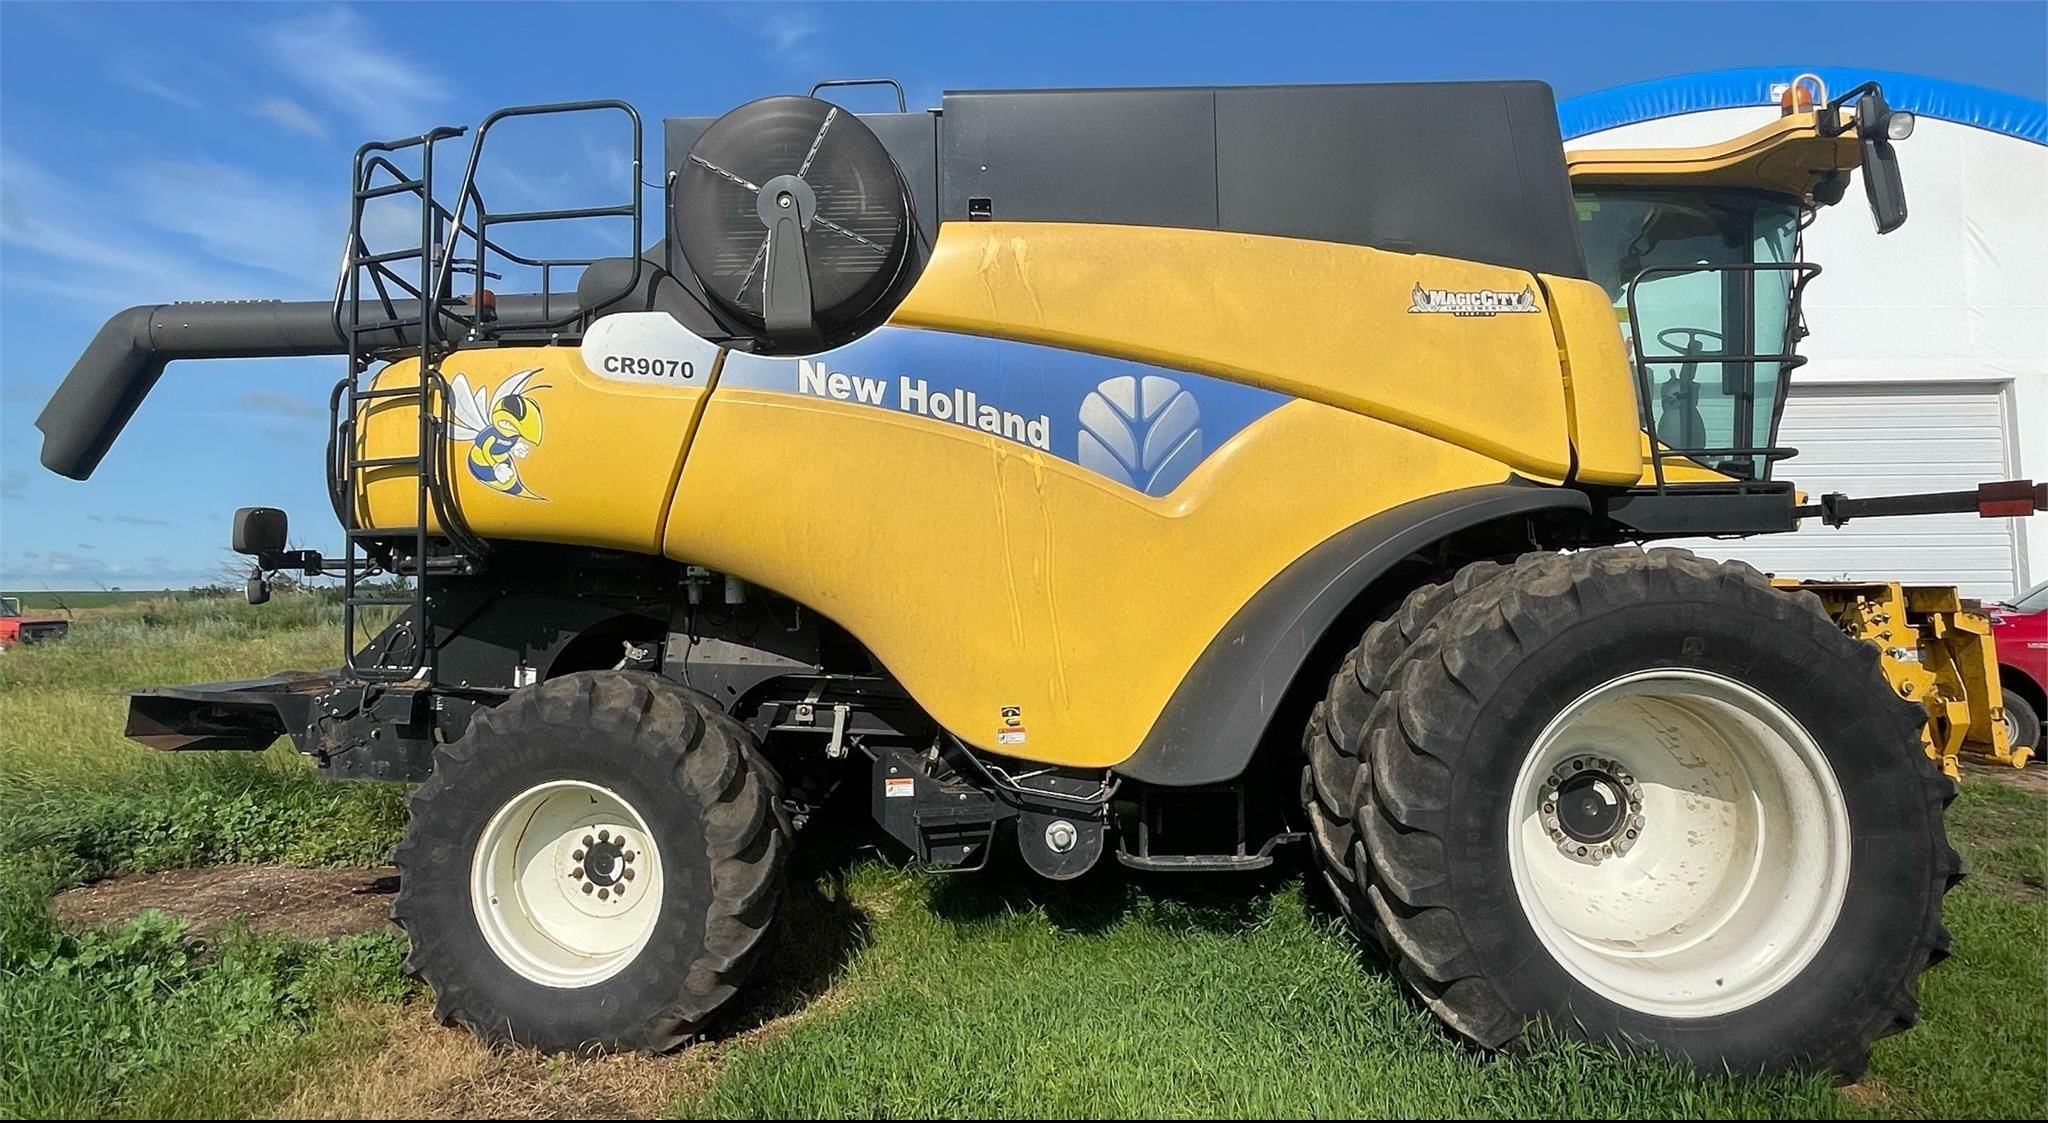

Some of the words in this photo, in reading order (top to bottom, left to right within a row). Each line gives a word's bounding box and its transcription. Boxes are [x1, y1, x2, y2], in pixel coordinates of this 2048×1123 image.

[603, 355, 695, 379] CR9070
[798, 359, 888, 406] New
[899, 375, 1050, 451] Holland
